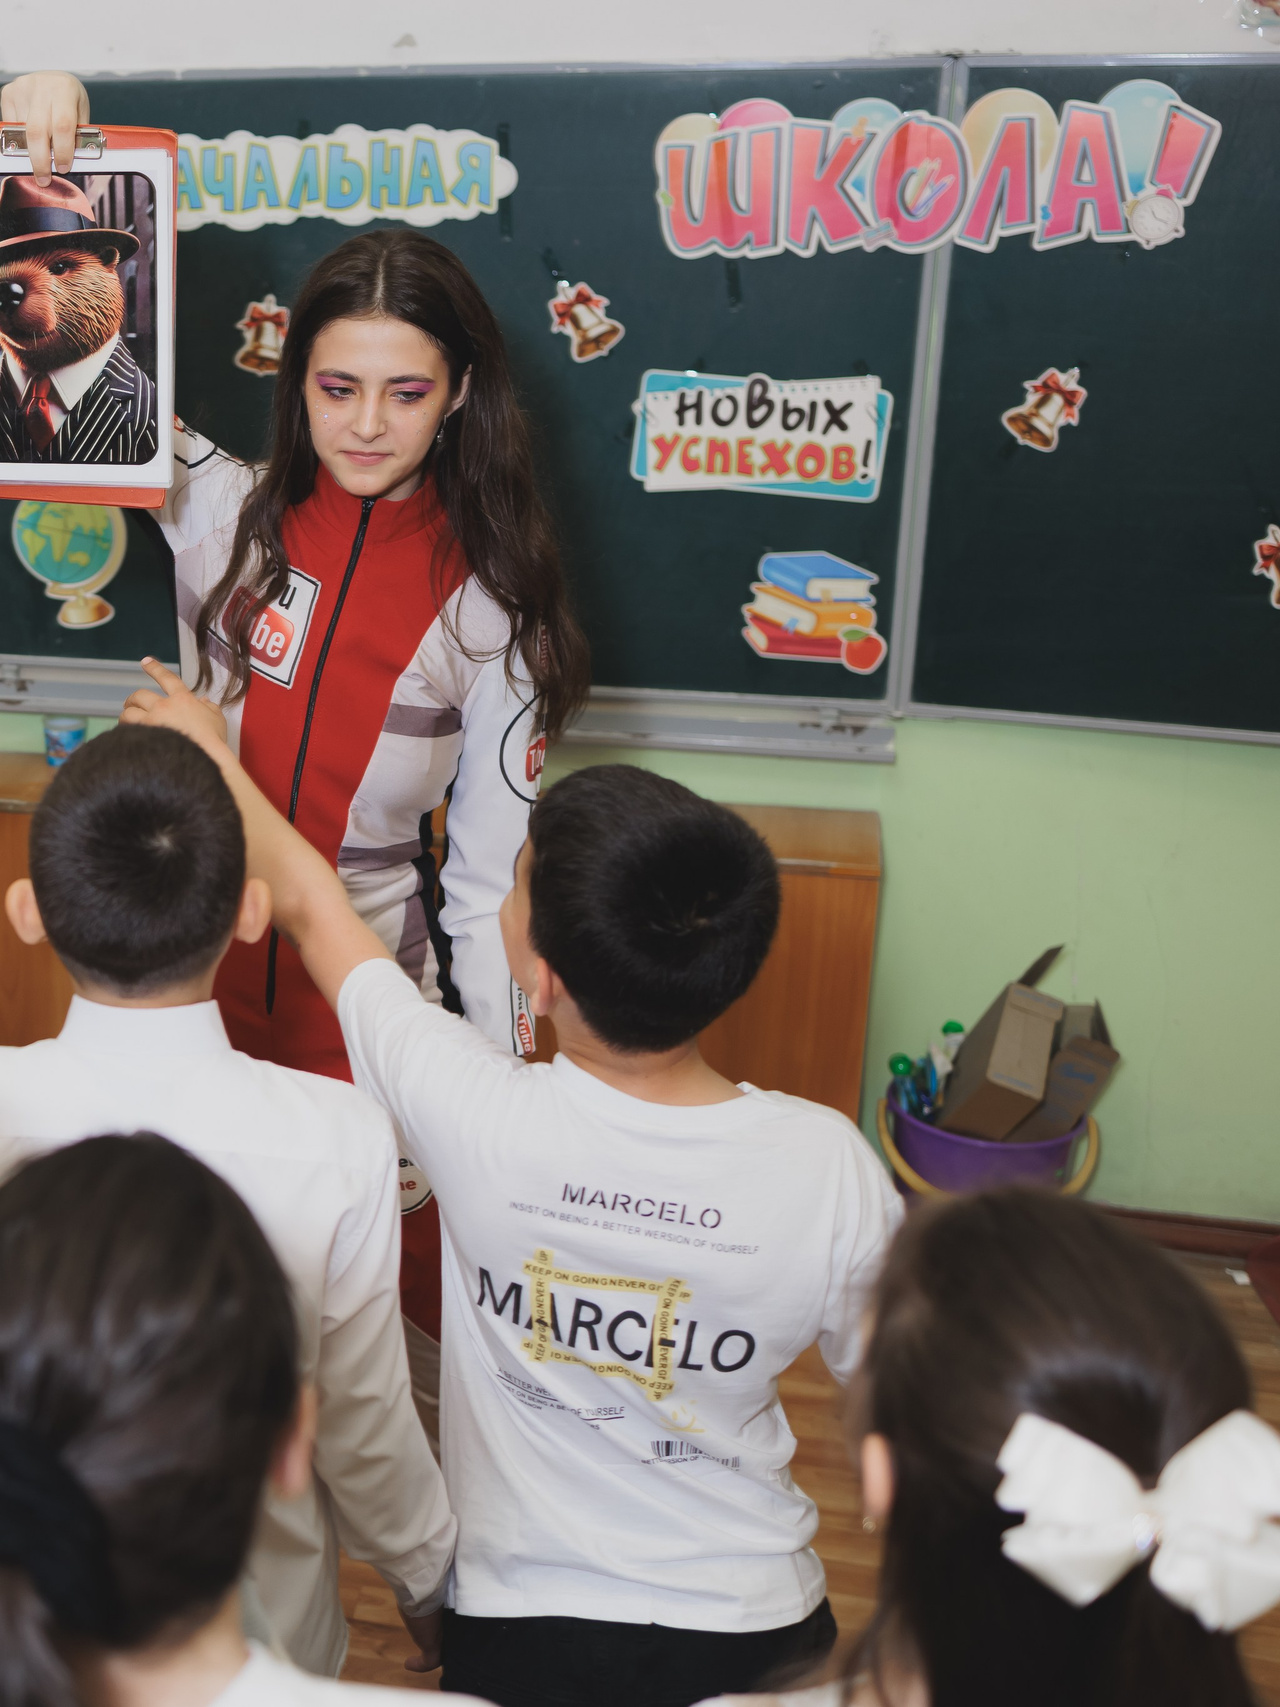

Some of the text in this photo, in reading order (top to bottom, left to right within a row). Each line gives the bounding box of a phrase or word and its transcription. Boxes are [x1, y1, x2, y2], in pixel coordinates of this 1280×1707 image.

[663, 104, 1215, 251] ШКОЛА!
[651, 434, 872, 482] УСПЕХОВ!
[519, 1016, 532, 1052] Tube
[561, 1182, 723, 1230] MARCELO
[509, 1201, 540, 1214] INSIST
[542, 1208, 556, 1219] ON
[559, 1212, 589, 1226] BEING
[592, 1219, 600, 1228] A
[602, 1220, 641, 1236] BETTER
[693, 1238, 707, 1248] OF
[711, 1242, 760, 1255] YOURSELF
[524, 1263, 552, 1277] KEEP
[554, 1271, 570, 1281] ON
[667, 1279, 682, 1298] KEEP
[661, 1298, 672, 1310] ON
[534, 1343, 546, 1362] KEEP
[633, 1373, 647, 1385] ON
[649, 1381, 674, 1391] KEEP
